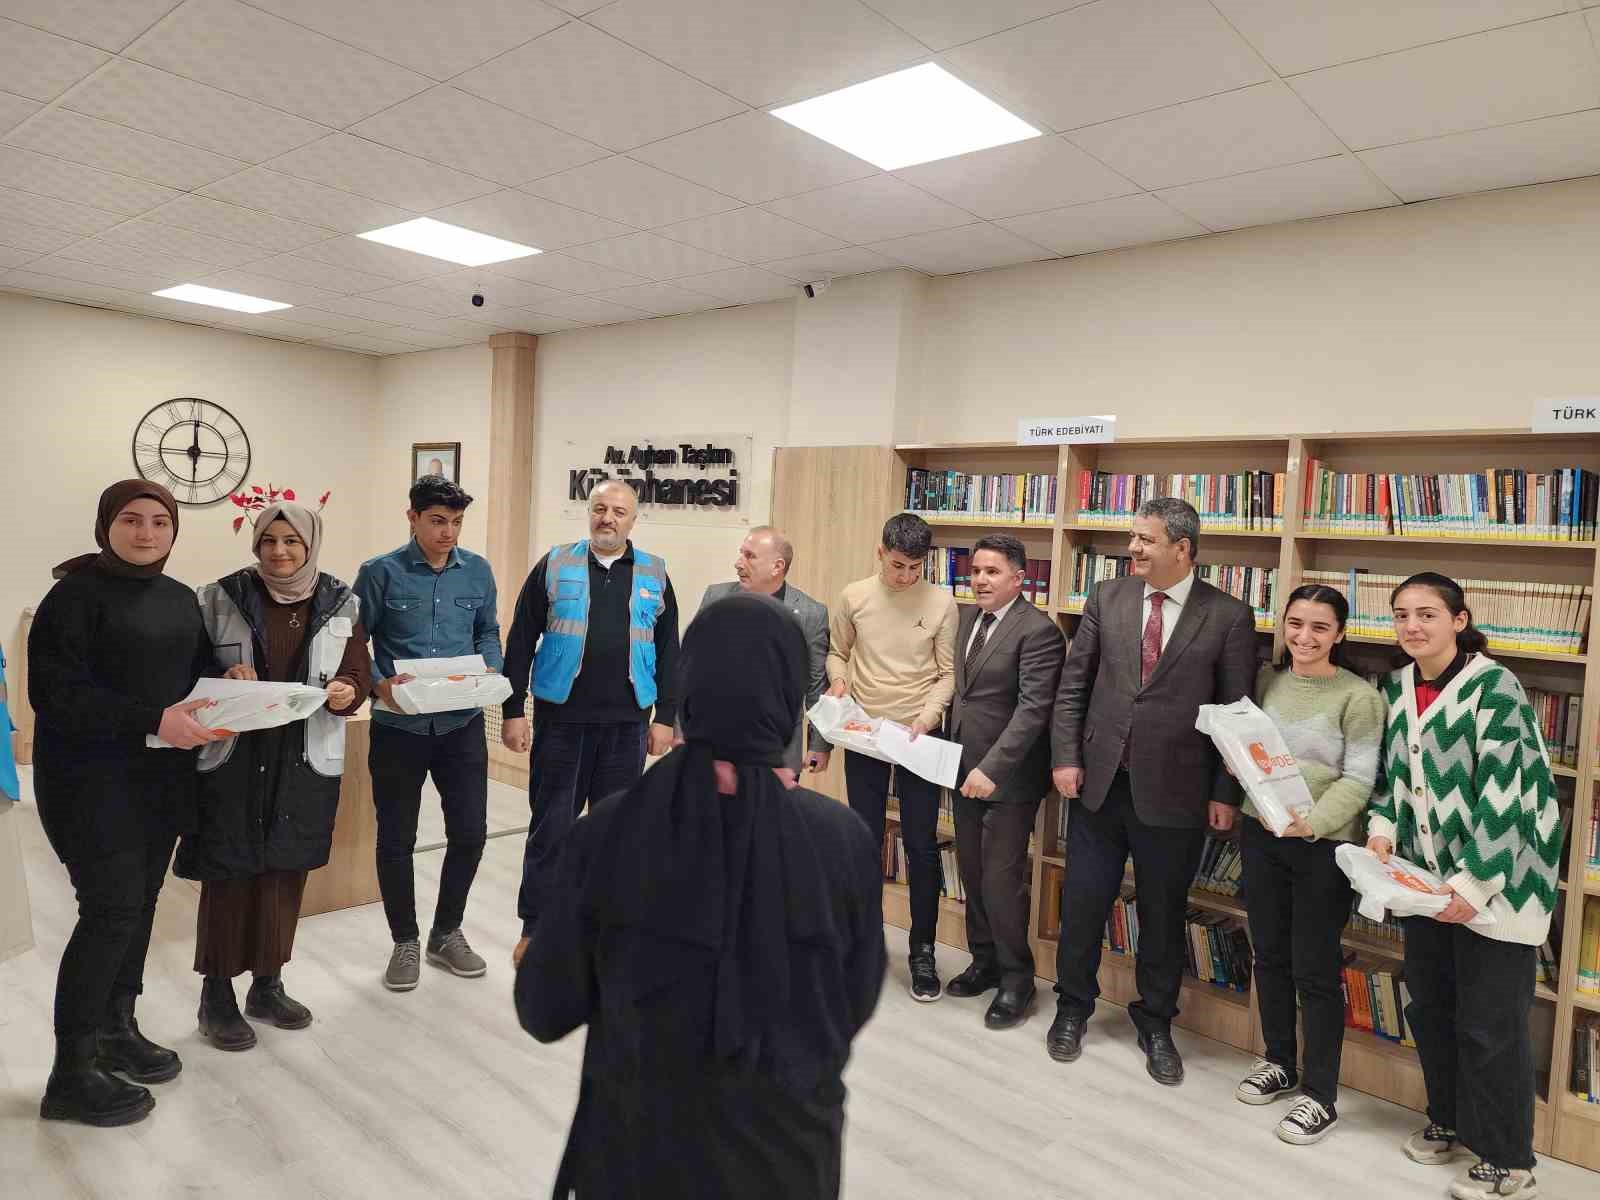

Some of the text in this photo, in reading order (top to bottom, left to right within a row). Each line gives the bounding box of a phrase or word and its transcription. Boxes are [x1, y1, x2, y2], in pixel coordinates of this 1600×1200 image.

[1551, 405, 1597, 420] TÜRK
[1029, 423, 1104, 437] TÜRK EDEBİYATI
[627, 444, 678, 470] Ayhan
[568, 468, 738, 507] Küphanesi
